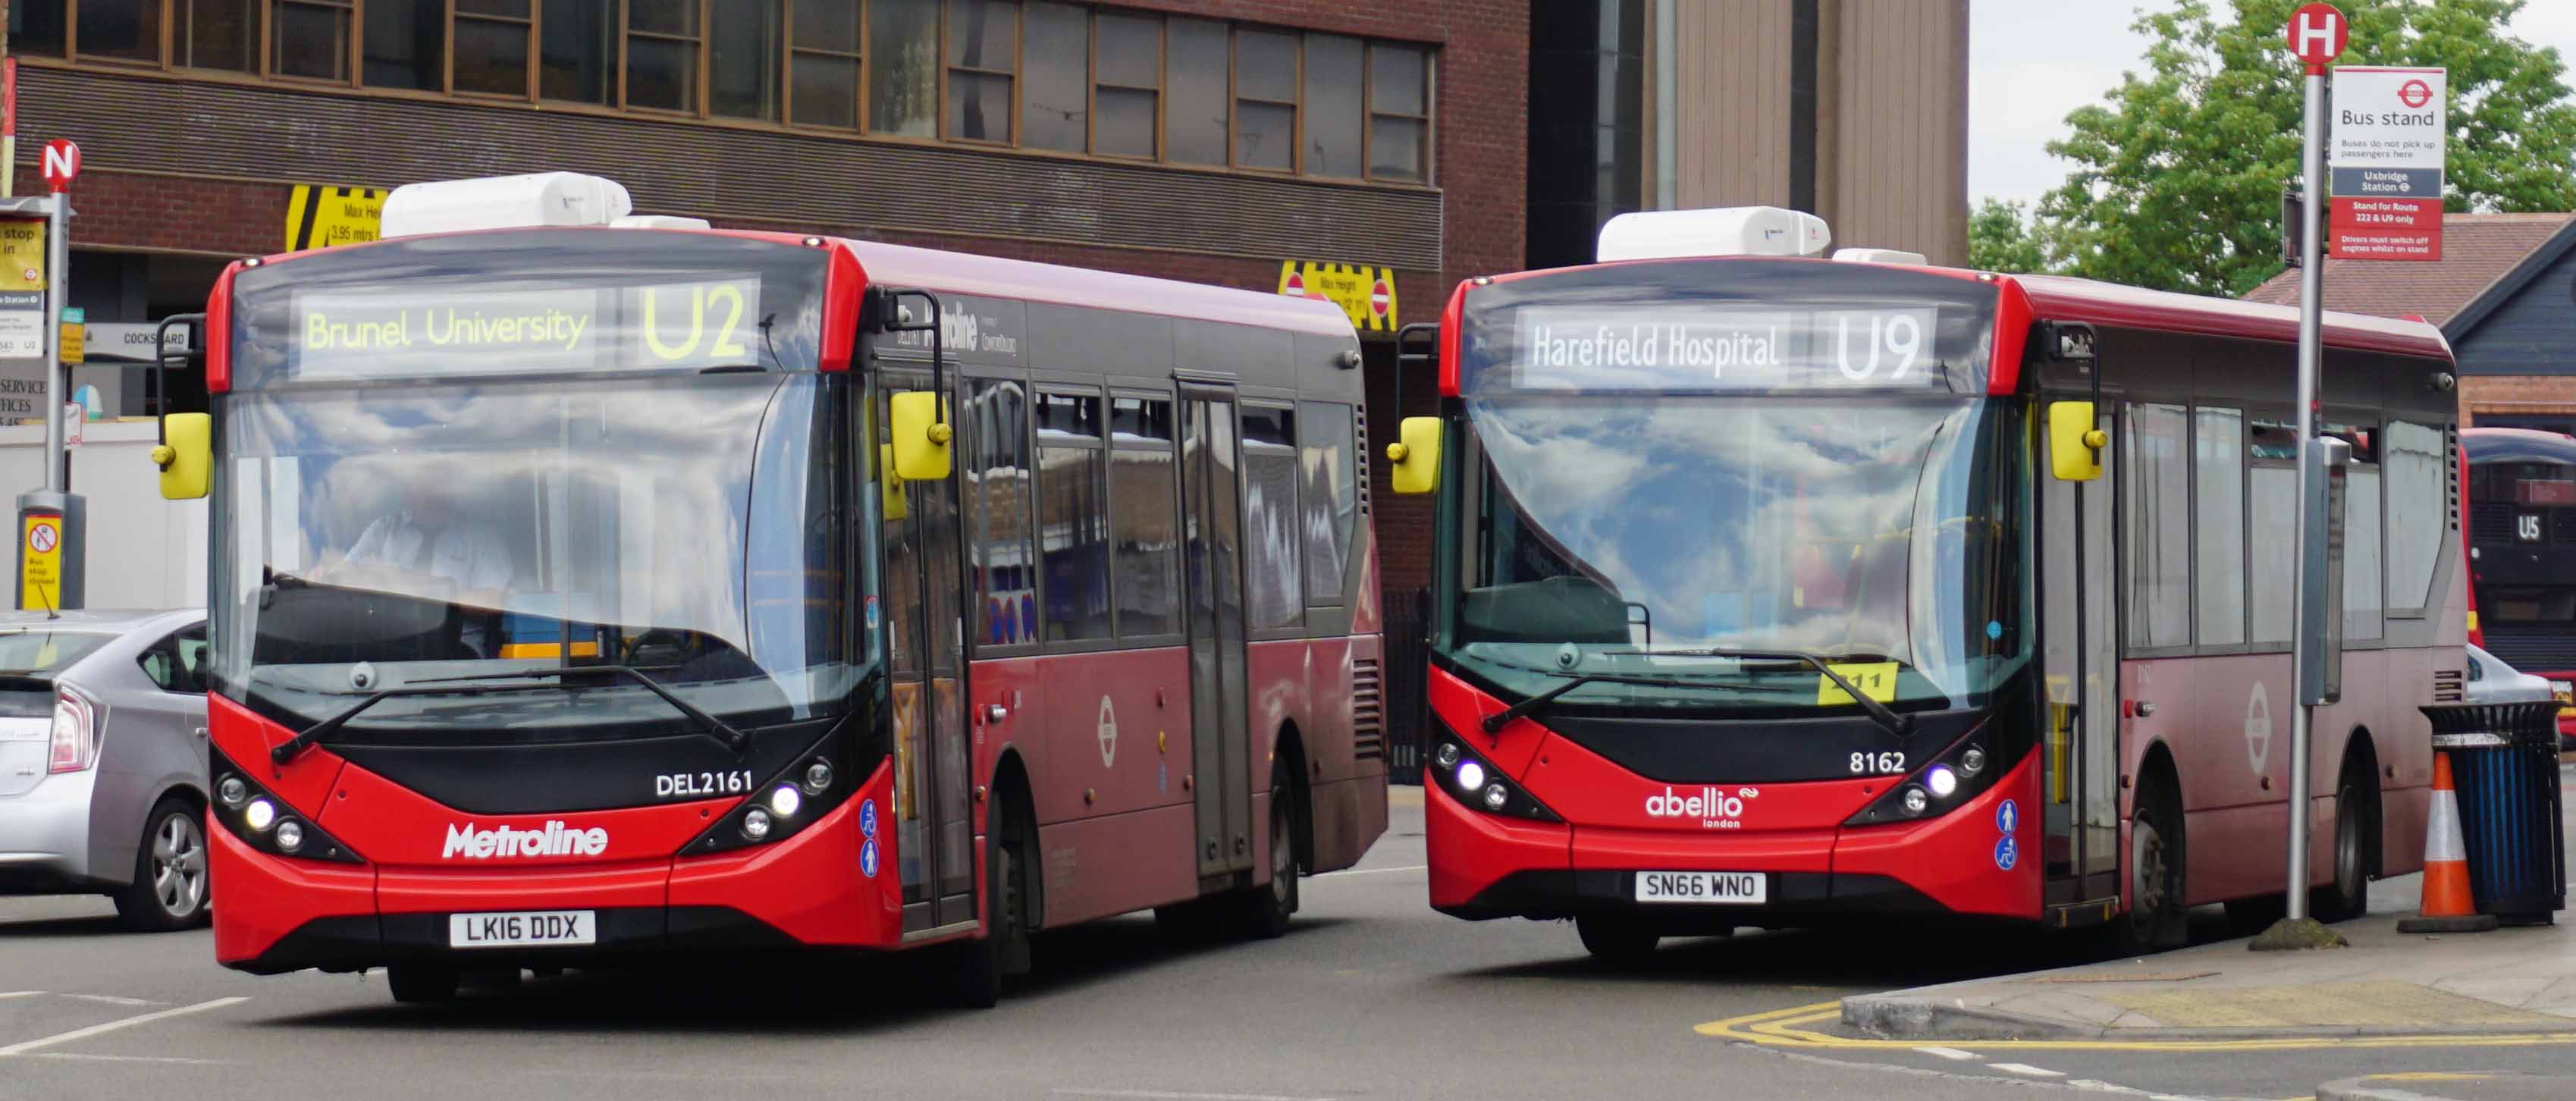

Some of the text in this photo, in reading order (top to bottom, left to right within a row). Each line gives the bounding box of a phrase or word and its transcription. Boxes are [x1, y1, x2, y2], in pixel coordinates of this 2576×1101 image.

[2298, 13, 2336, 57] H
[2342, 110, 2433, 126] Bus stand
[2403, 140, 2421, 149] pick
[45, 145, 74, 177] N
[2361, 182, 2397, 192] Station
[2364, 171, 2408, 183] Uxbridge
[345, 203, 363, 218] Max
[2353, 202, 2377, 210] Stand
[2392, 203, 2418, 212] Route
[2355, 214, 2371, 222] 222
[2381, 215, 2394, 223] U9
[2396, 215, 2414, 224] only
[5, 227, 35, 243] stop
[331, 225, 350, 240] 3.95
[353, 228, 374, 241] mtrs
[307, 307, 588, 351] Brunel University
[644, 284, 746, 360] U2
[924, 298, 977, 352] Mtroline
[124, 333, 185, 345] COCKSARD
[1837, 314, 1921, 381] U9
[1533, 325, 1780, 378] Harefield Hospital
[1, 379, 47, 394] SERVICE
[2518, 516, 2539, 539] U5
[1850, 752, 1905, 773] 8162
[657, 770, 752, 796] DEL2161
[1646, 786, 1743, 817] abellio
[1703, 819, 1740, 829] london
[442, 820, 609, 858] Metroline
[1646, 874, 1755, 896] SN66 WNO
[467, 915, 579, 941] LK16 DDX
